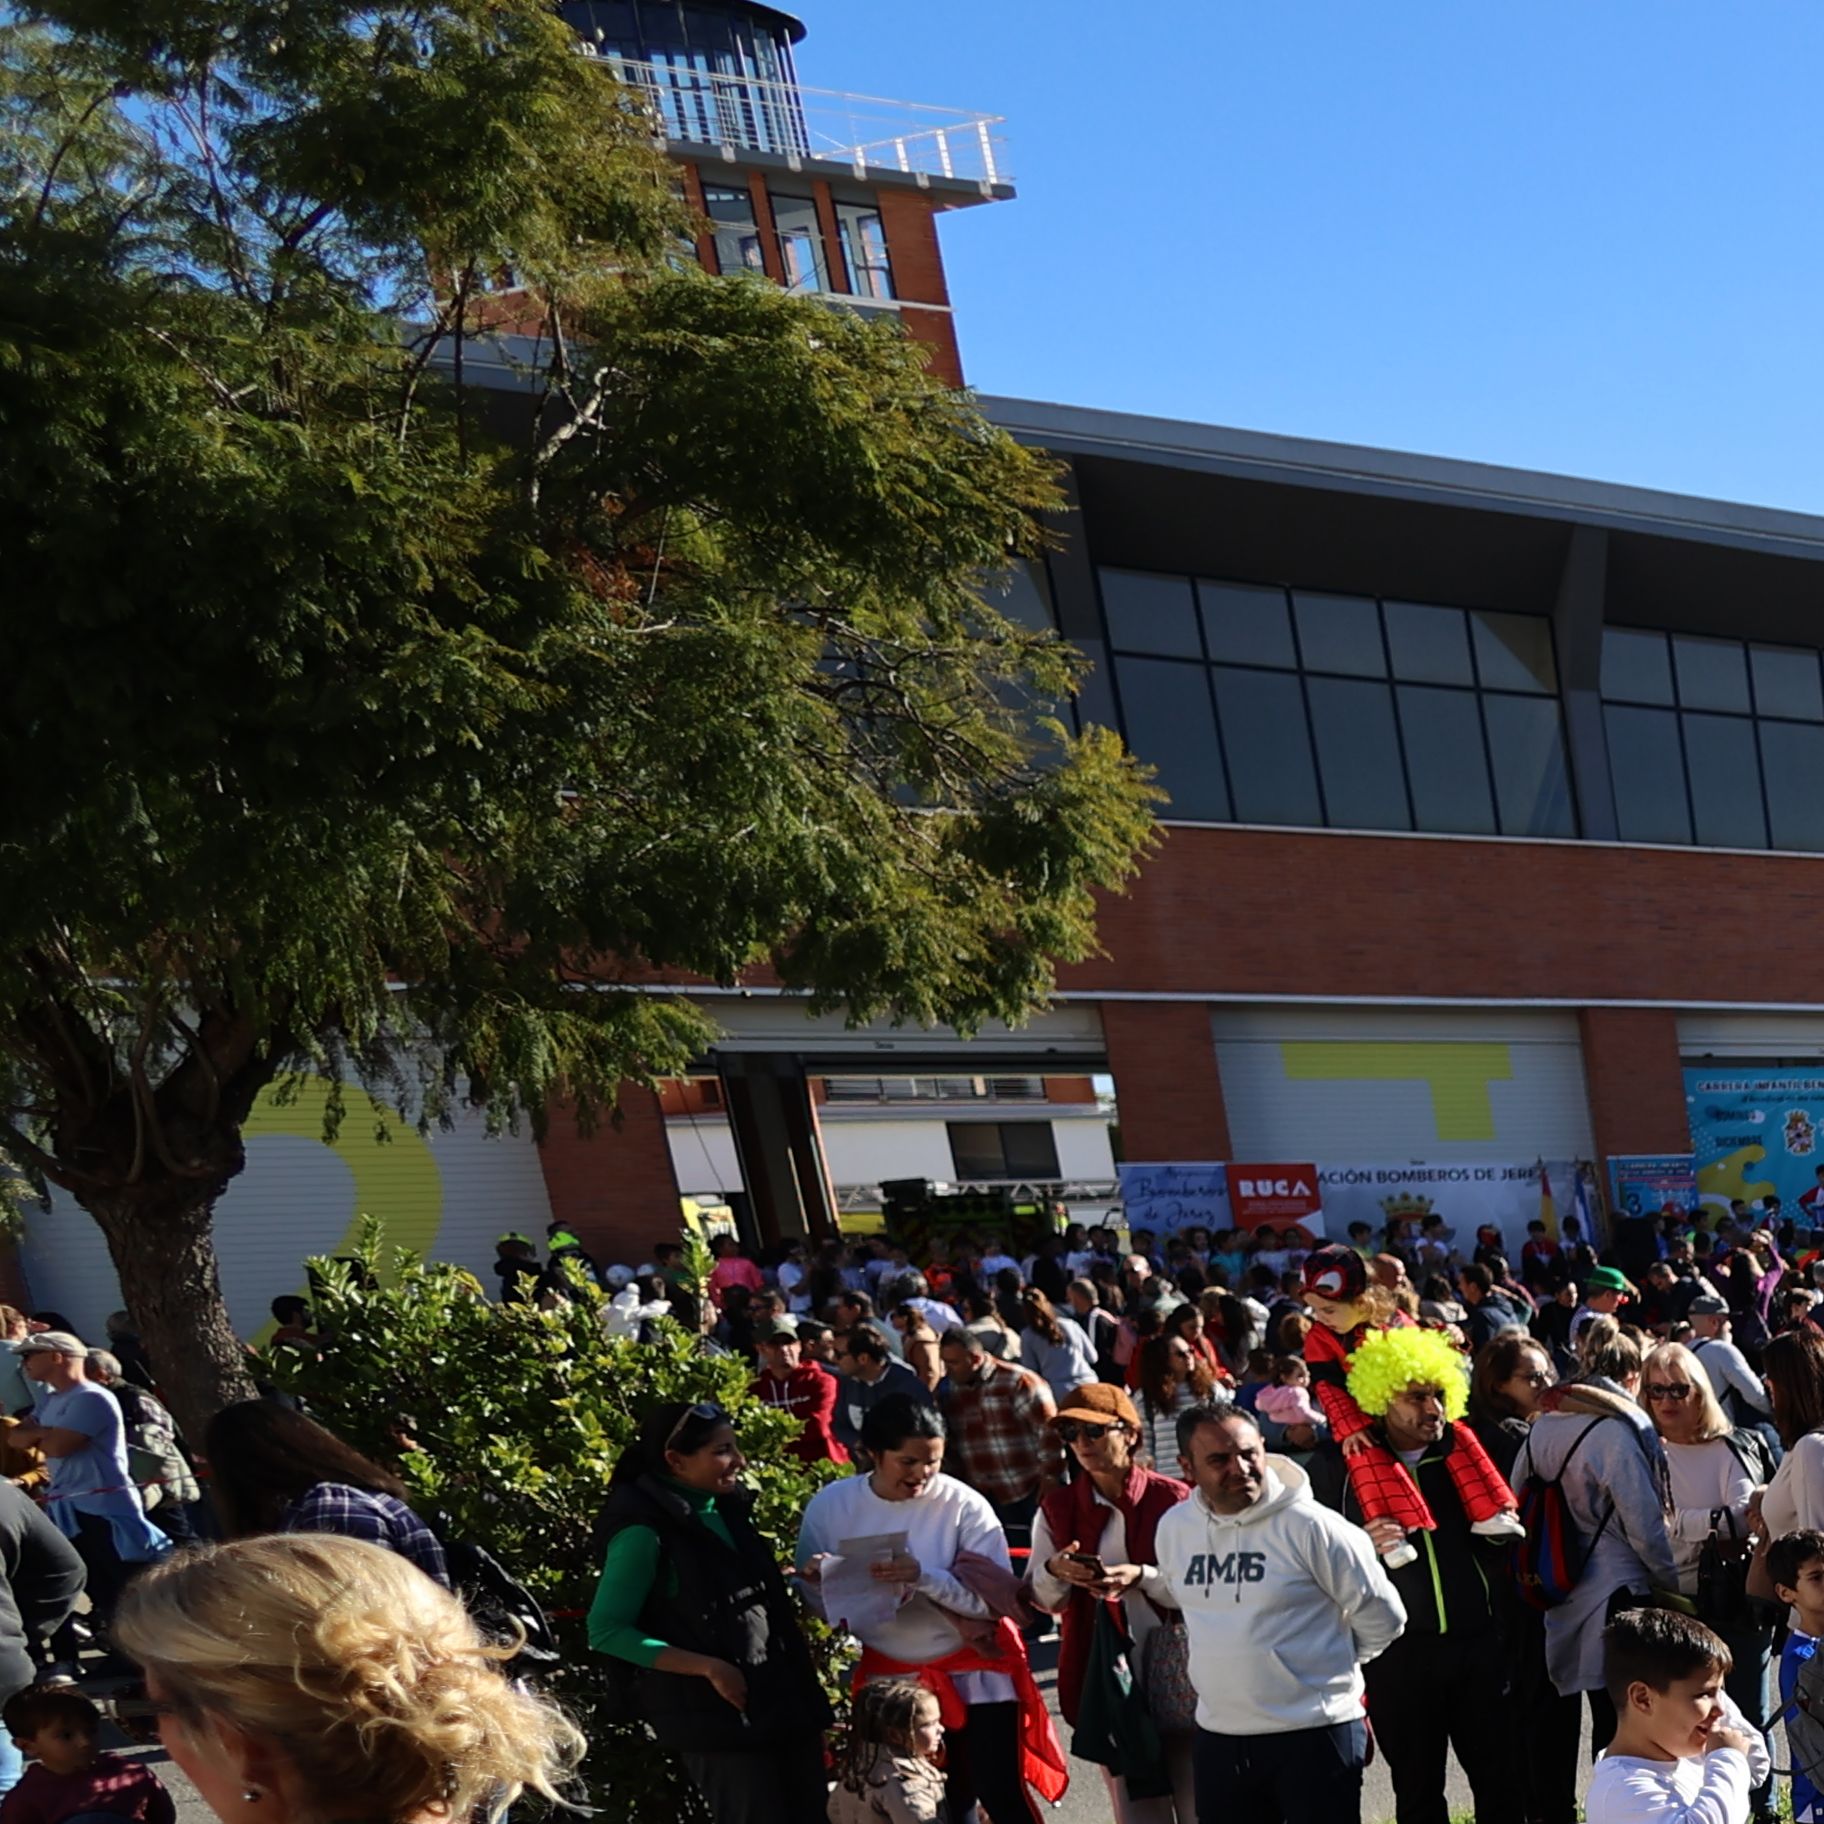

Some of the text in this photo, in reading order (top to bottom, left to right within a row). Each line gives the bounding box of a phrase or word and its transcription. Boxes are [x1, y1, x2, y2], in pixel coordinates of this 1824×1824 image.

[1318, 1166, 1537, 1184] ACIÓN BOMBEROS DE JERE
[1239, 1179, 1311, 1198] RUCA
